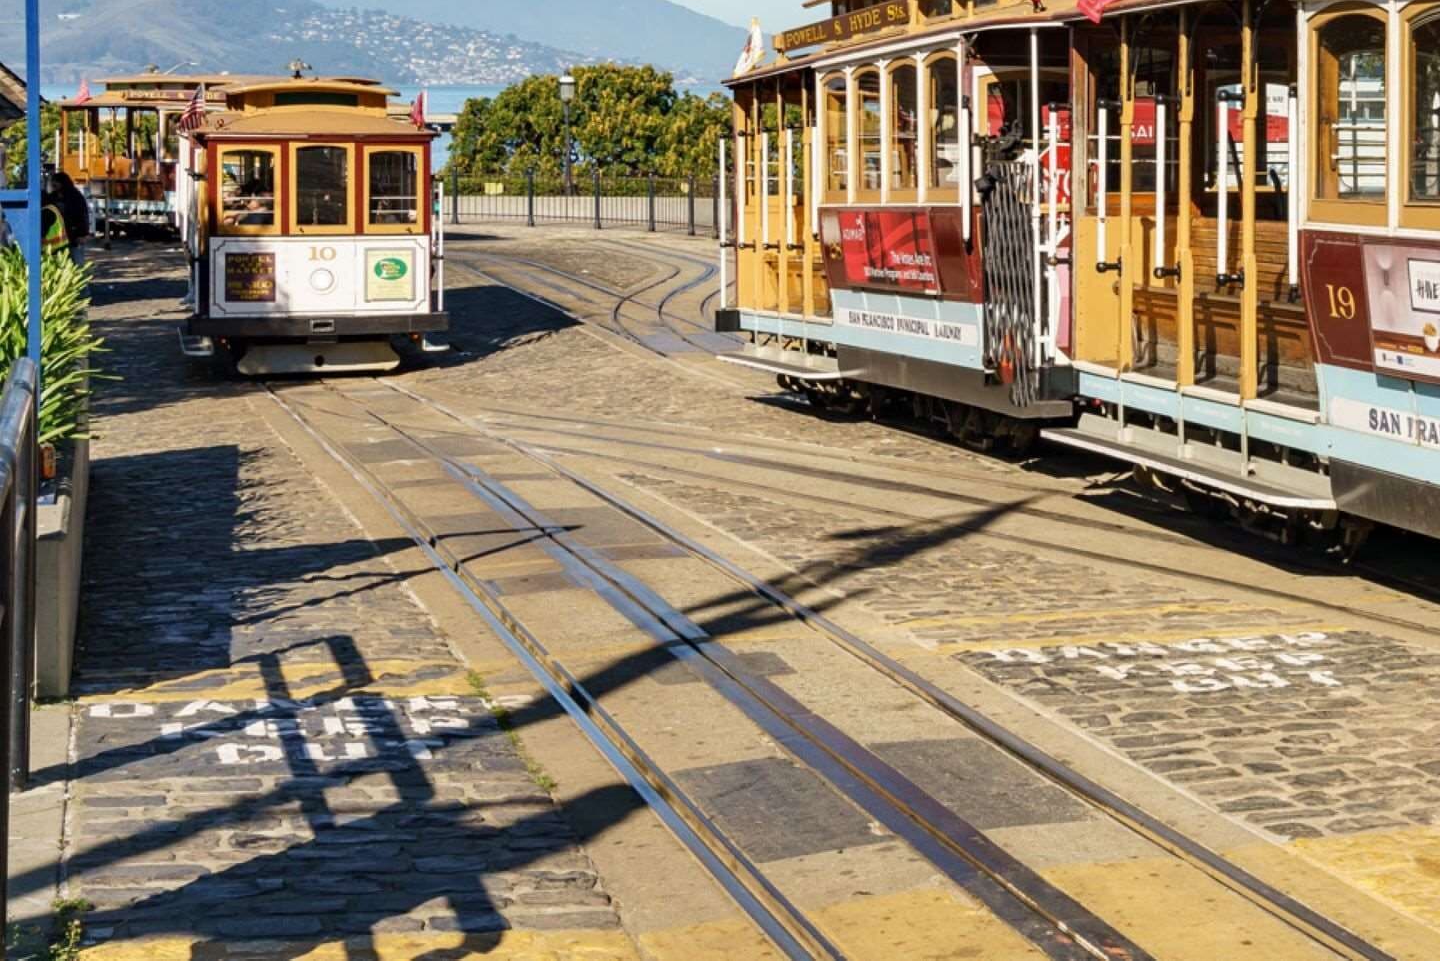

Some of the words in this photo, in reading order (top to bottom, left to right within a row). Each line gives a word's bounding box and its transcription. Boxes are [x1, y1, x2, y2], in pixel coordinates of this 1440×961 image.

[785, 25, 827, 48] POWELL
[849, 9, 881, 32] HYDE
[887, 4, 906, 21] Sts.
[308, 246, 337, 261] 10
[1325, 283, 1356, 320] 19
[848, 311, 860, 324] SAN
[1368, 407, 1401, 436] SAN
[215, 738, 447, 765] OUT
